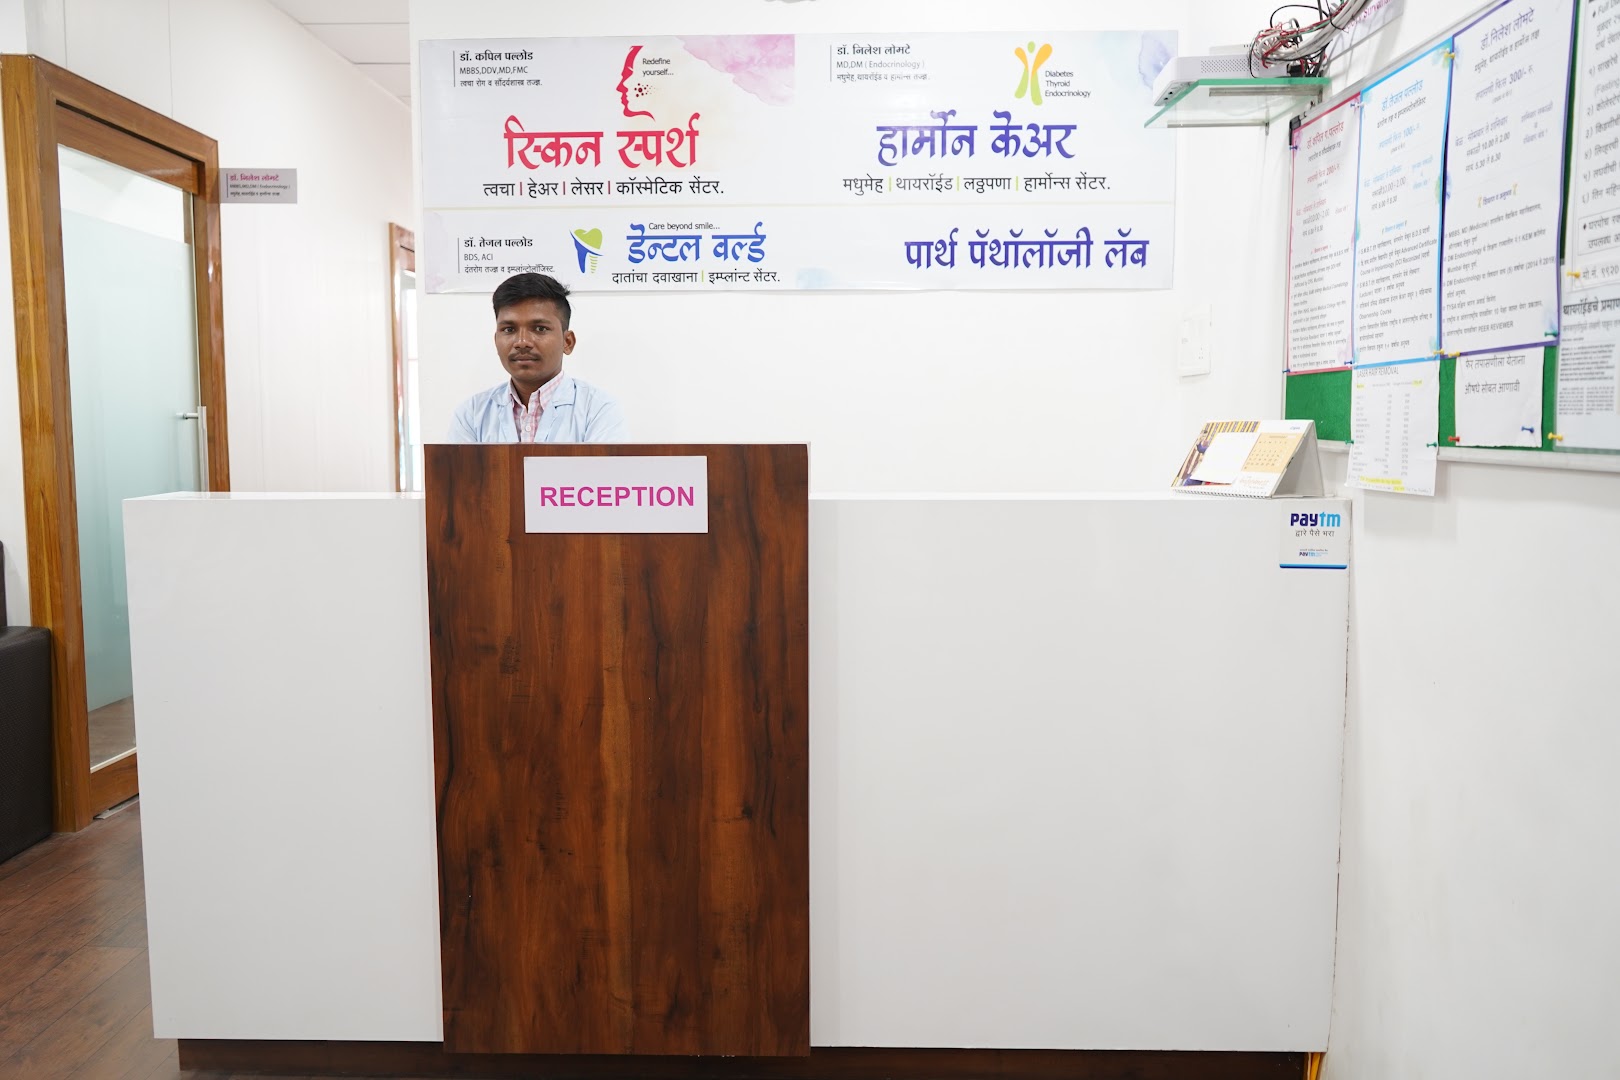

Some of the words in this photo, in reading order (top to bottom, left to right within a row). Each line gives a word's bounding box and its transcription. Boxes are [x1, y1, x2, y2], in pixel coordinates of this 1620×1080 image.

[460, 50, 472, 61] डॉ.
[475, 49, 502, 61] कपिल
[505, 49, 533, 61] पल्लोड
[837, 44, 849, 55] डॉ.
[852, 43, 881, 55] निलेश
[884, 43, 911, 55] लोमटे
[642, 57, 671, 65] Redefine
[1045, 70, 1074, 78] Diabetes
[1045, 80, 1070, 88] Thyroid
[1045, 90, 1091, 98] Endocrinology
[503, 115, 604, 170] स्किन
[616, 112, 700, 169] स्पर्श
[876, 109, 978, 167] हार्मोन
[990, 109, 1077, 159] केअर
[483, 182, 515, 197] त्वचा
[527, 178, 559, 199] हेअर
[571, 177, 603, 196] लेसर
[616, 177, 683, 195] कॉस्मेटिक
[842, 174, 883, 196] मधुमेह
[896, 174, 953, 193] थायरॉईड
[1024, 172, 1071, 193] हार्मोन्स
[649, 222, 665, 230] Care
[667, 222, 692, 231] beyond
[464, 237, 476, 248] डॉ.
[479, 237, 502, 248] तेजल
[505, 236, 533, 247] पल्लोड
[627, 223, 702, 264] डेन्टल
[712, 221, 767, 263] वर्ल्ड
[904, 227, 959, 269] पार्थ
[968, 226, 1094, 269] पॅथॉलॉजी
[1104, 228, 1150, 269] लॅब
[481, 253, 493, 261] ACI
[612, 269, 648, 284] दातांचा
[652, 272, 698, 284] दवाखाना
[540, 486, 694, 507] RECEPTION
